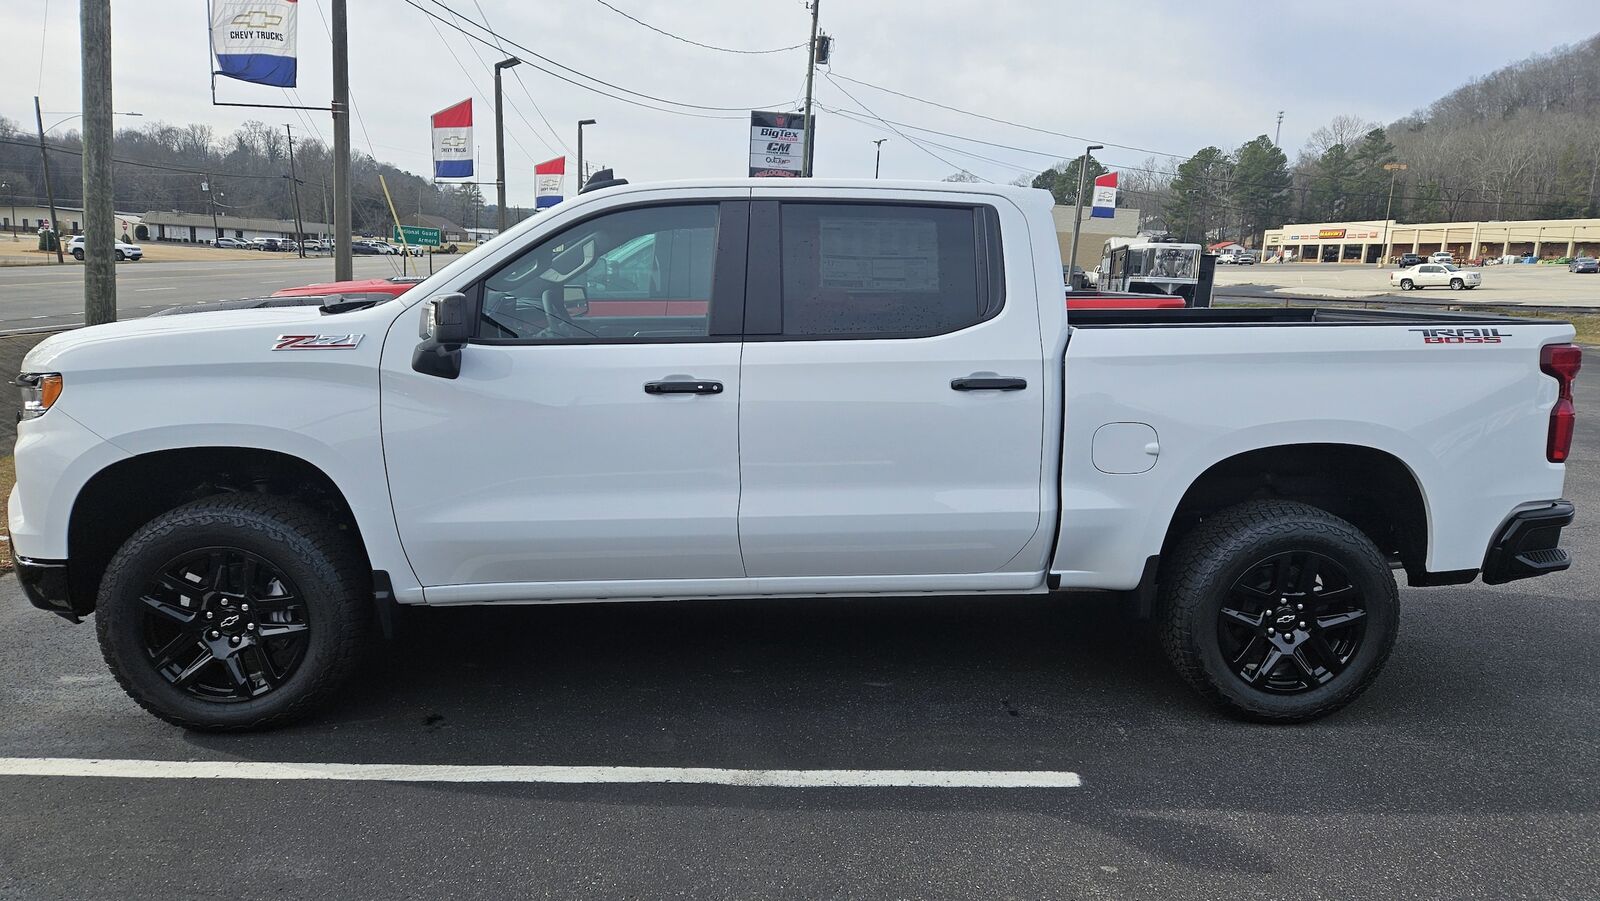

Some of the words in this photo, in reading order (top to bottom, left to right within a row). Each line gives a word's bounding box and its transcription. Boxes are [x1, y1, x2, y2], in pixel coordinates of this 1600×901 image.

[230, 31, 255, 40] CHEVY
[256, 31, 284, 42] TRUCKS
[418, 237, 437, 245] Armory
[1408, 328, 1512, 337] TRAIL
[271, 333, 366, 351] Z71
[1424, 336, 1502, 344] BOSS
